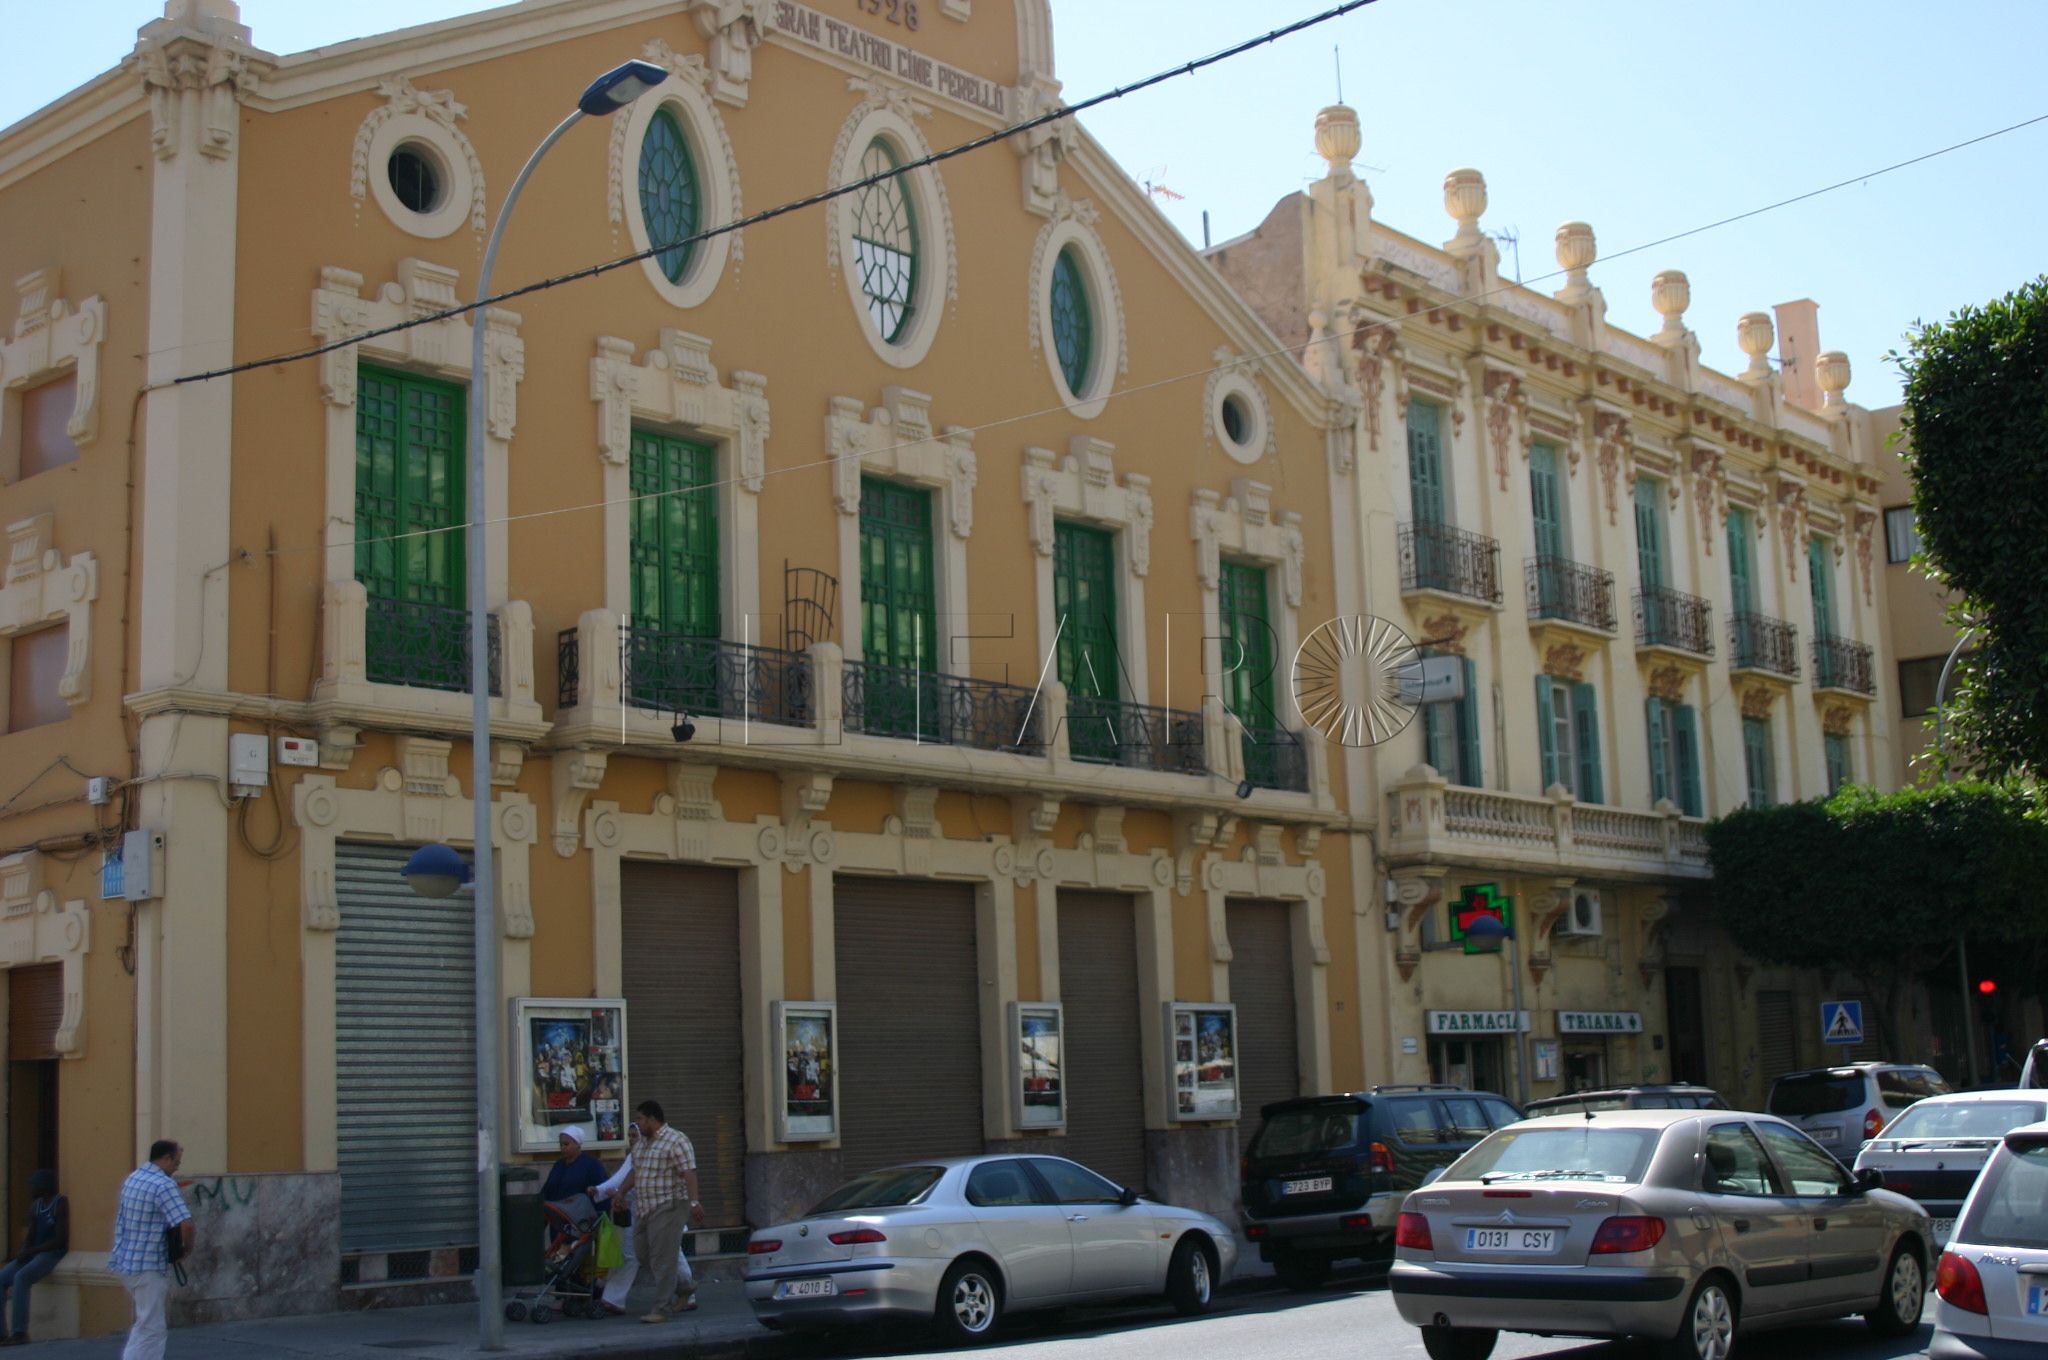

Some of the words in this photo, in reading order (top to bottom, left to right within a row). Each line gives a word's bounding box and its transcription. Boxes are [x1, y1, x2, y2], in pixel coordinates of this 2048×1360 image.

[774, 1, 820, 43] GRAN
[825, 18, 892, 72] TEATRO
[897, 48, 933, 88] CINE
[1437, 1013, 1520, 1030] FARMACIA
[1565, 1014, 1624, 1030] TRIANA
[1478, 1231, 1509, 1248] 0131
[1523, 1232, 1552, 1249] CSY
[799, 1282, 821, 1295] 4010
[824, 1280, 830, 1293] E
